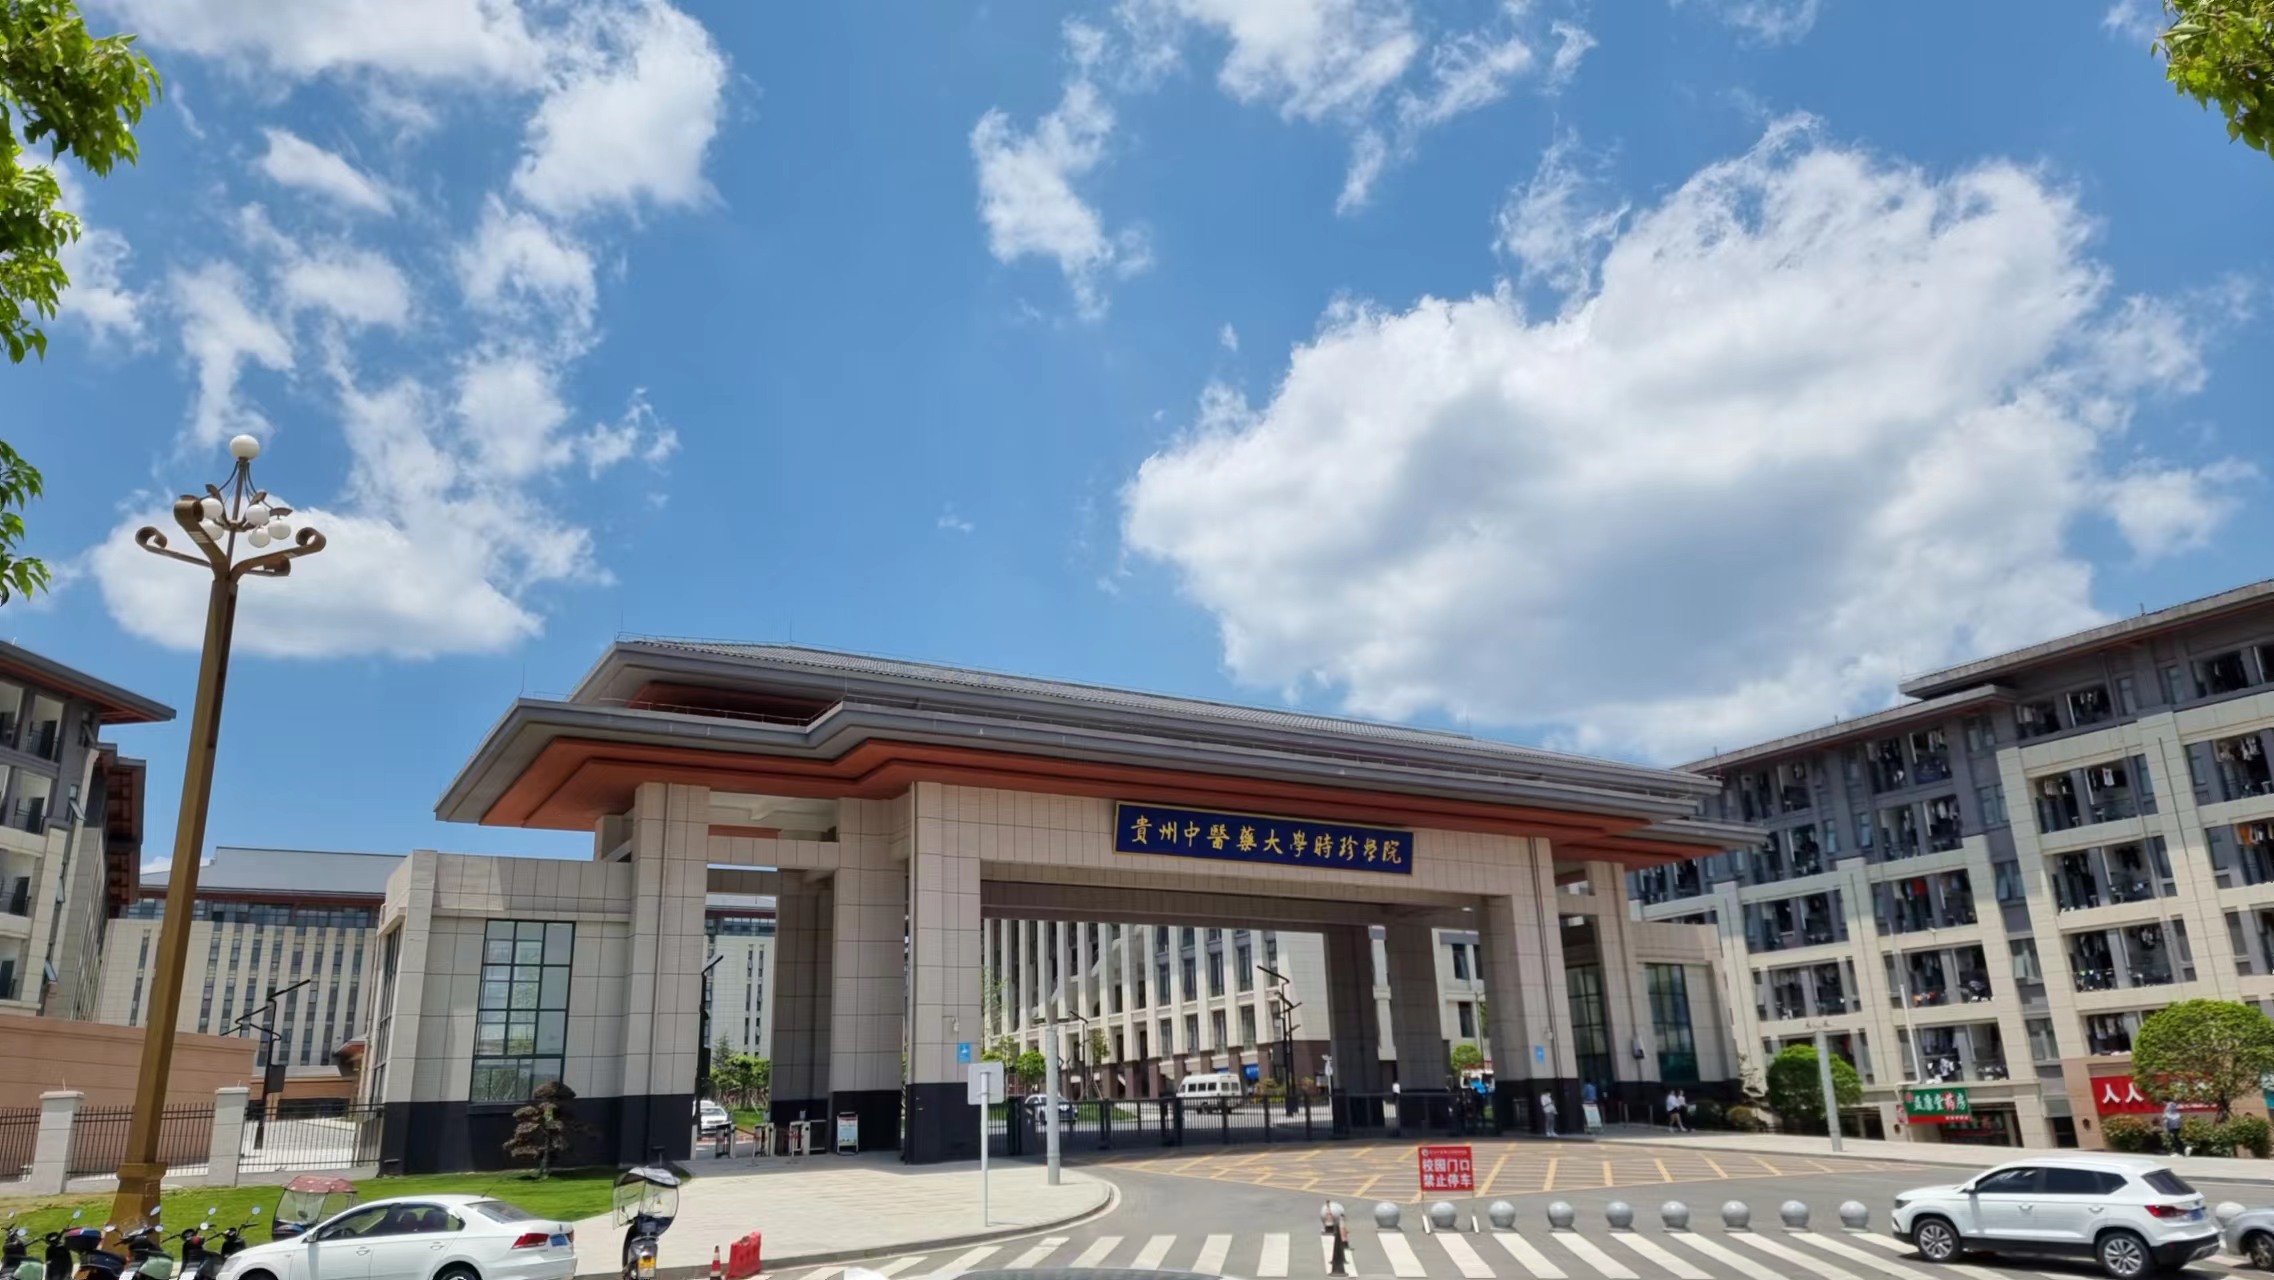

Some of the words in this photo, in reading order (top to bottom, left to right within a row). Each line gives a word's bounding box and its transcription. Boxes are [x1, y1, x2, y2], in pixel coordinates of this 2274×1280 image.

[1423, 1158, 1470, 1173] 校园门口
[1423, 1173, 1472, 1188] 禁止停车
